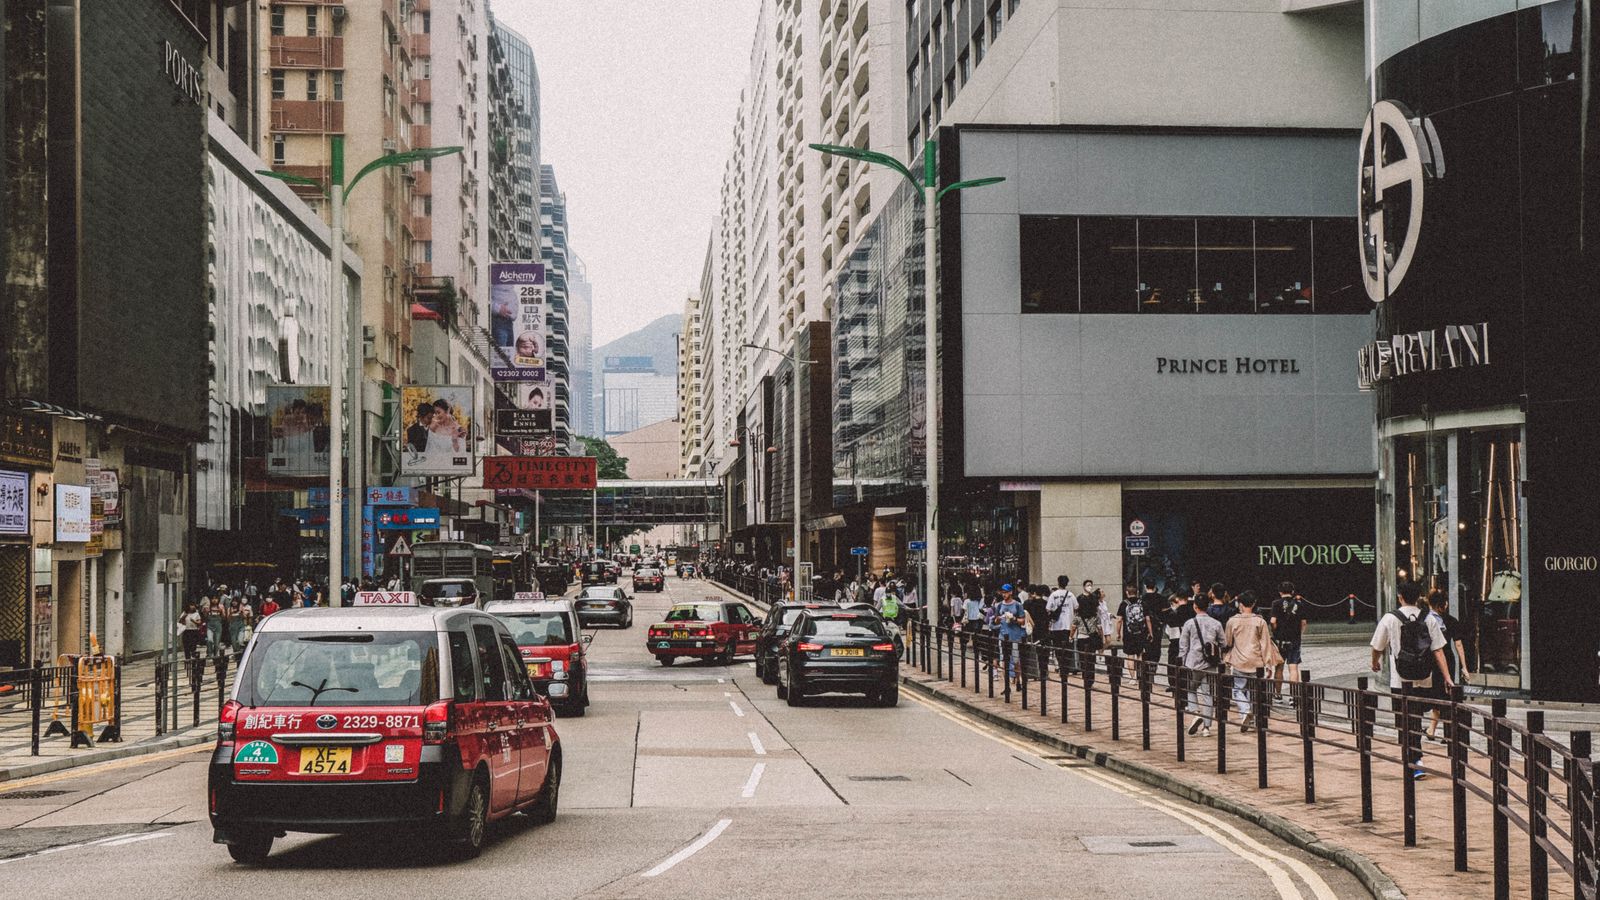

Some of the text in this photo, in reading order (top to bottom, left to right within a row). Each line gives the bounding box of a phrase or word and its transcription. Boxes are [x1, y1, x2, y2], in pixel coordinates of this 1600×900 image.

[165, 40, 201, 105] PORTS
[499, 271, 537, 282] Alchemy
[1392, 322, 1491, 376] ARMANI
[1156, 357, 1300, 374] PRINCE HOTEL
[516, 461, 591, 472] TIMECITY
[1258, 544, 1352, 565] EMPORIO
[1545, 556, 1598, 571] GIORGIO
[361, 593, 410, 604] TAXI
[244, 714, 303, 730] 創紀車行
[343, 715, 420, 729] 2329-8871
[252, 748, 262, 757] 4
[303, 761, 347, 774] 4574
